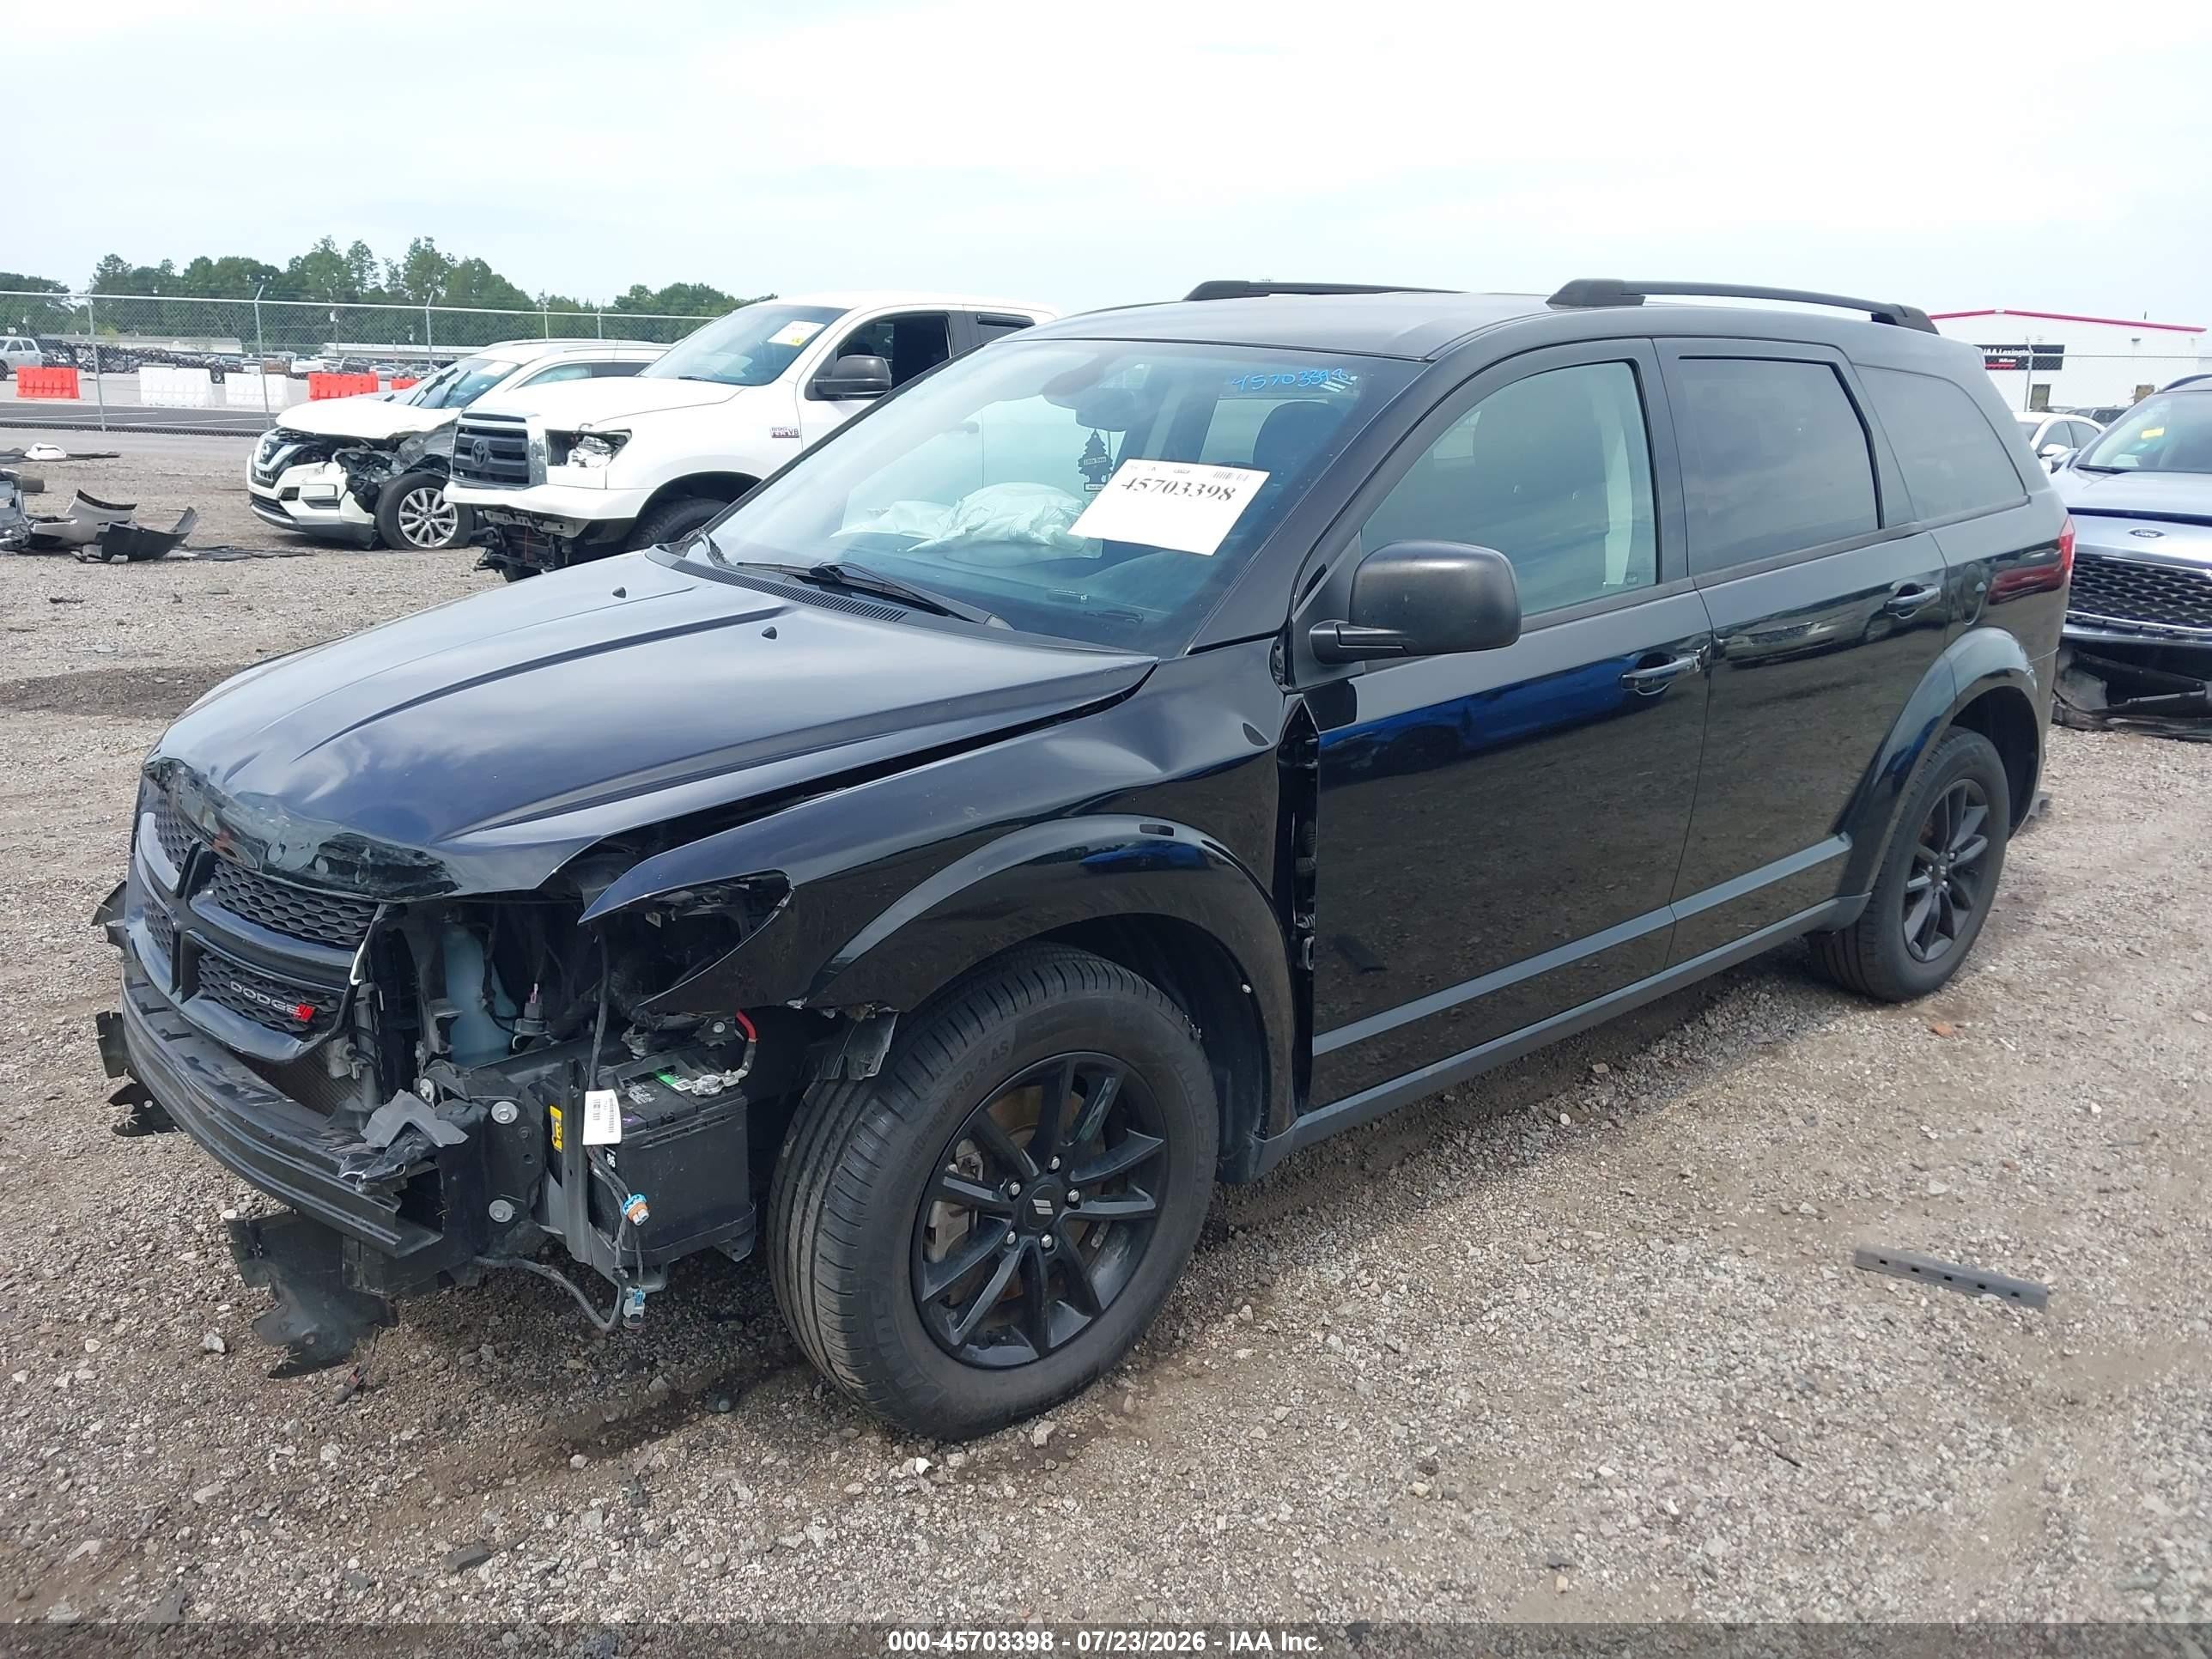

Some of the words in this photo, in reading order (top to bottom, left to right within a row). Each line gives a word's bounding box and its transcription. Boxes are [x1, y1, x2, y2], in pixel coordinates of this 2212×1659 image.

[1231, 368, 1346, 392] 45703398
[1121, 477, 1237, 501] 45703398
[230, 981, 301, 1017] DODGE
[990, 1040, 1010, 1062] AS
